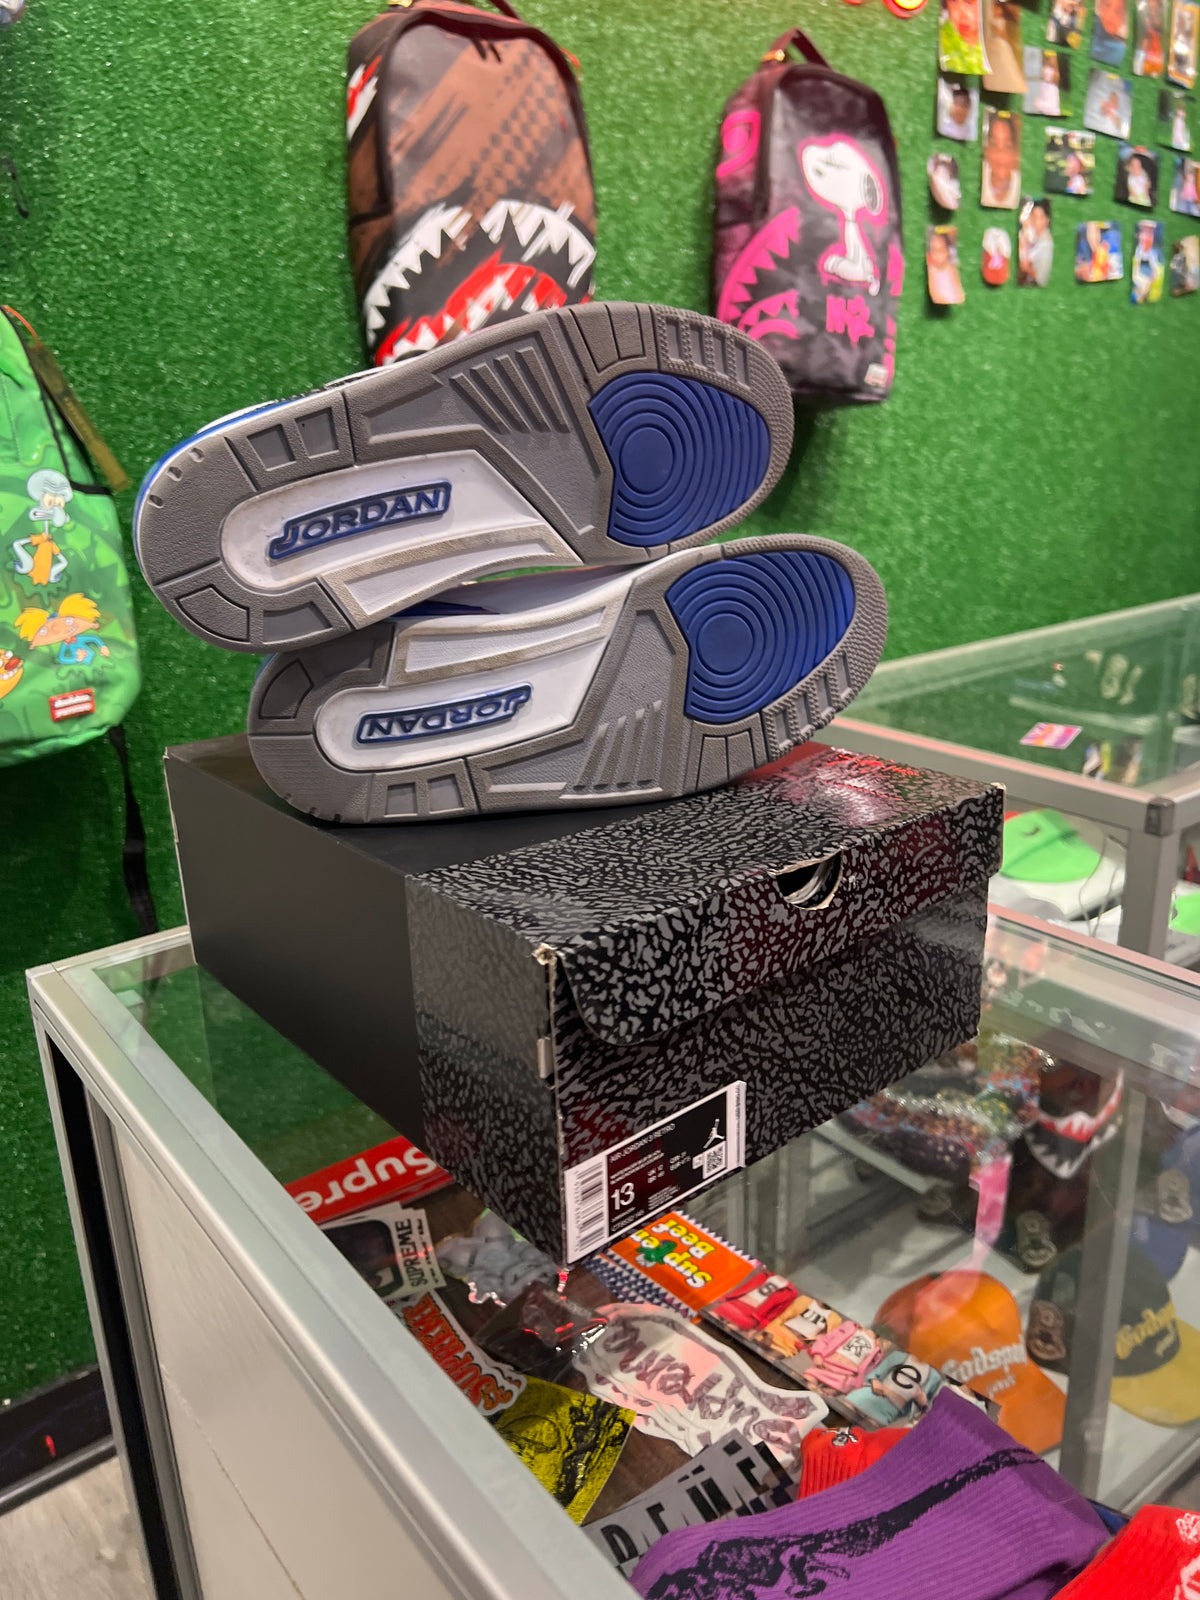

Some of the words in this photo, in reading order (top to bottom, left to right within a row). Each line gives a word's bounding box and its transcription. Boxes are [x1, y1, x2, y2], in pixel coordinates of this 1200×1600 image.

[271, 487, 443, 554] JORDAN
[366, 690, 527, 738] JORDAN
[610, 1182, 635, 1210] 13
[395, 1219, 428, 1287] SUPREME
[651, 1219, 715, 1259] Beef
